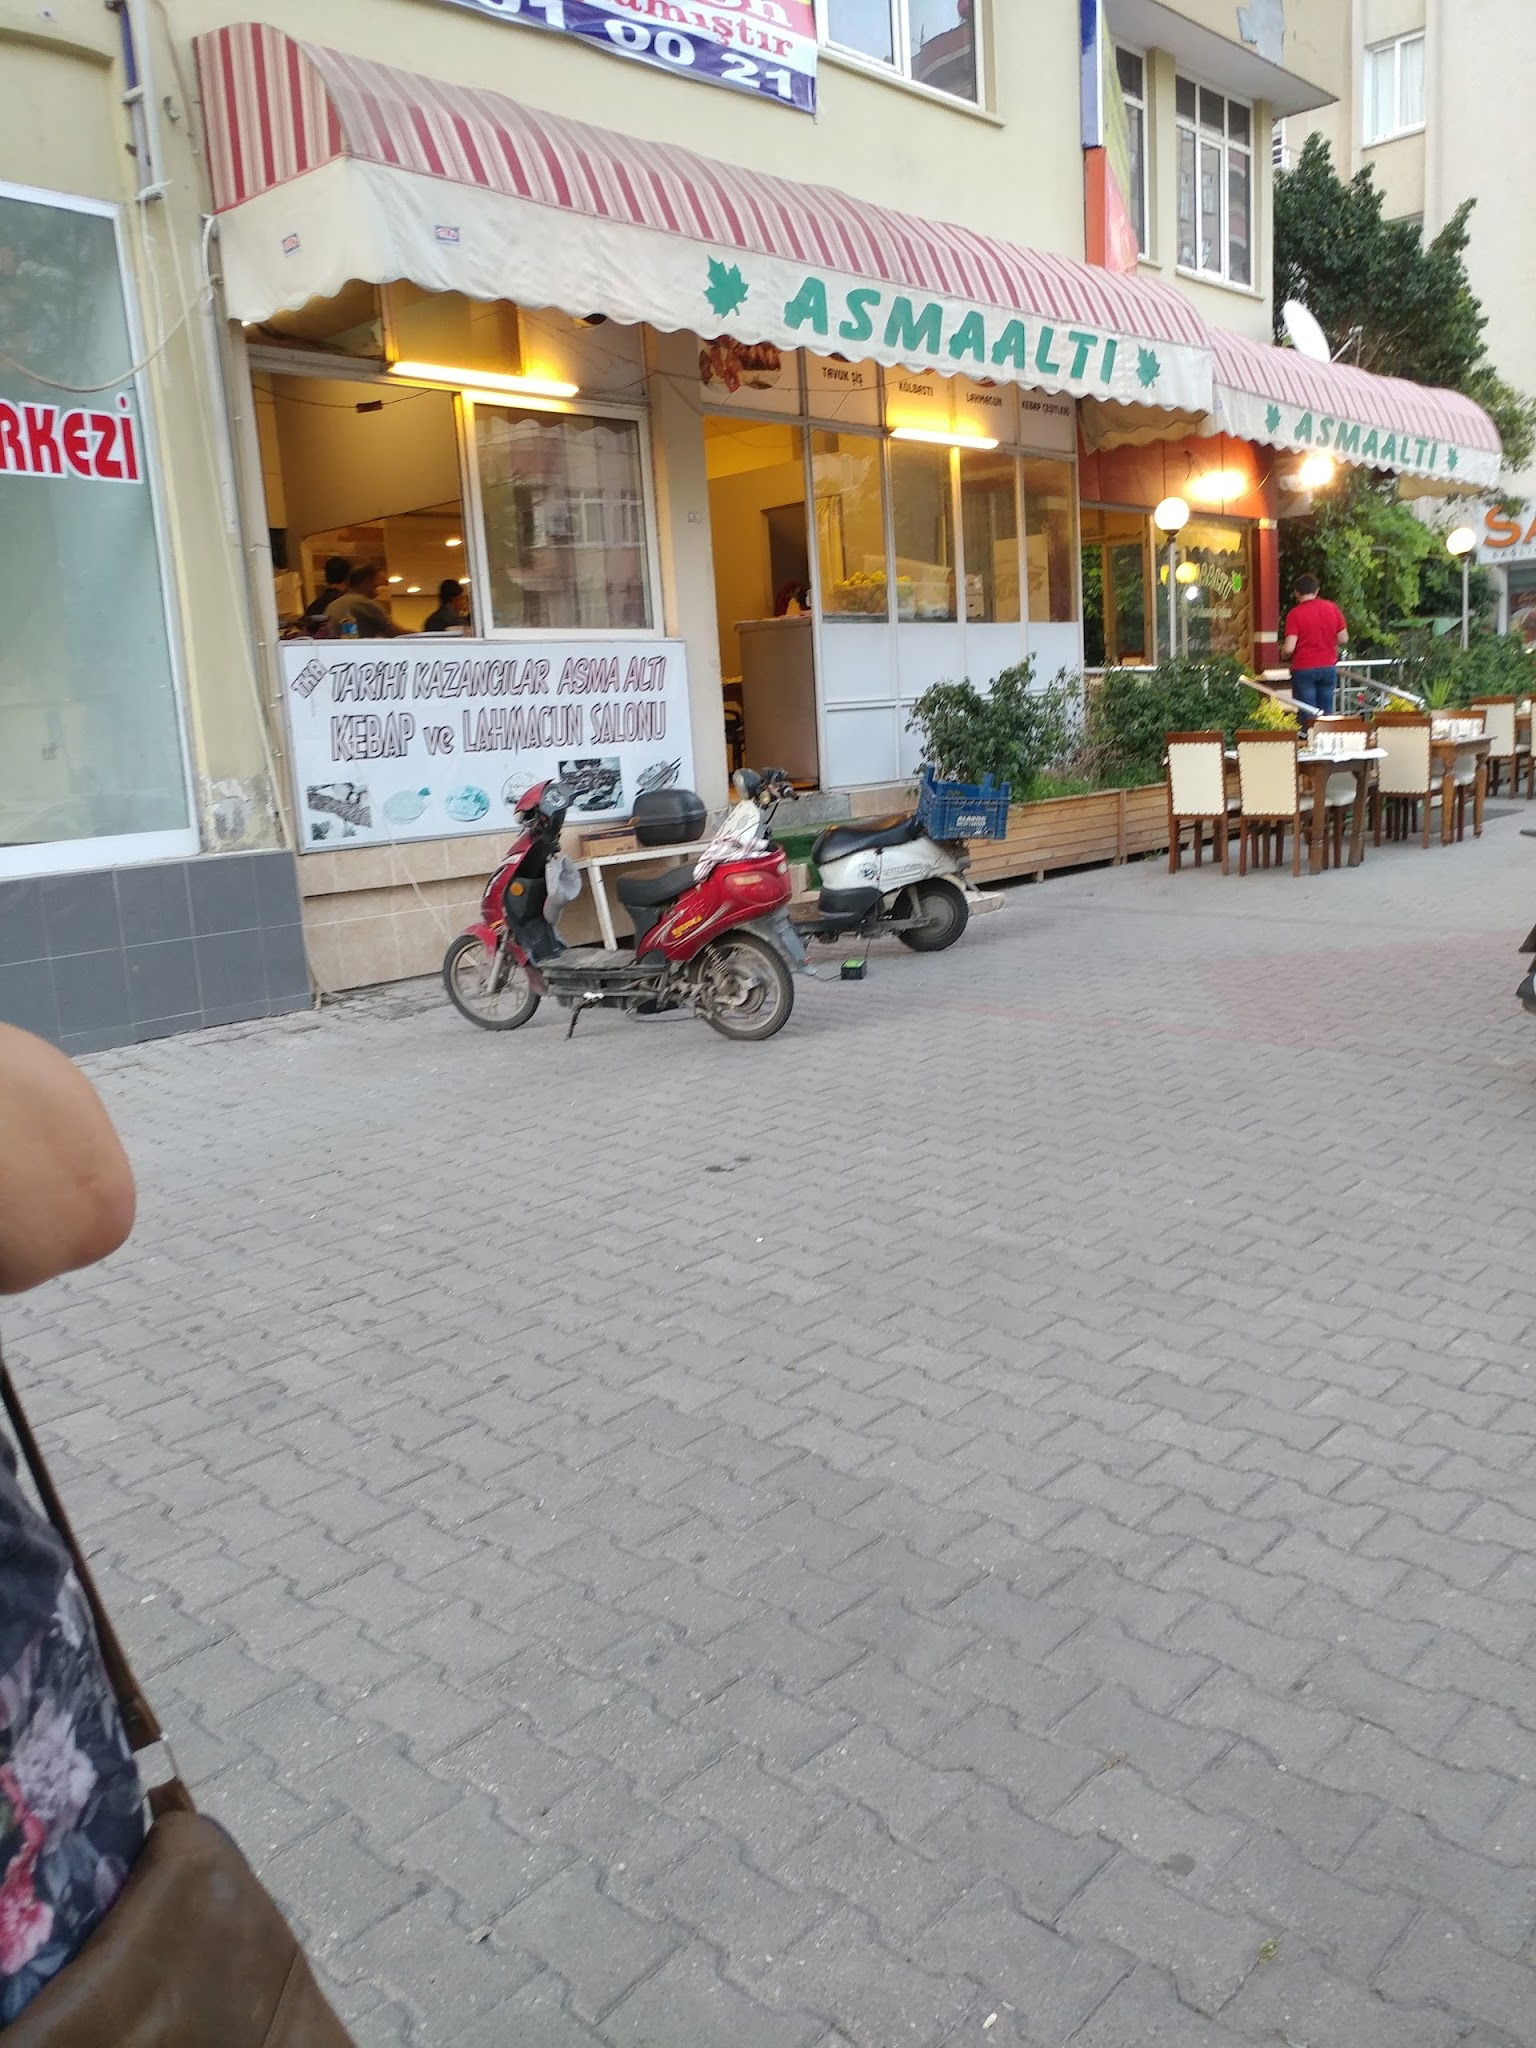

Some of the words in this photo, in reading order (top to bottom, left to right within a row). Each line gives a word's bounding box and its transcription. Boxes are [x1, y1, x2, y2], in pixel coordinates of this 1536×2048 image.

[603, 19, 696, 66] 00
[720, 53, 793, 99] 21
[783, 276, 1118, 384] ASMAALTI
[1294, 411, 1438, 470] ASMAALTI
[411, 657, 550, 699] KAZANCILAR
[556, 655, 620, 696] ASMA
[622, 654, 667, 694] ALTI
[330, 711, 416, 762] KEBAP
[423, 725, 456, 756] ve
[462, 702, 583, 756] LAHMACUN
[589, 699, 667, 746] SALONU
